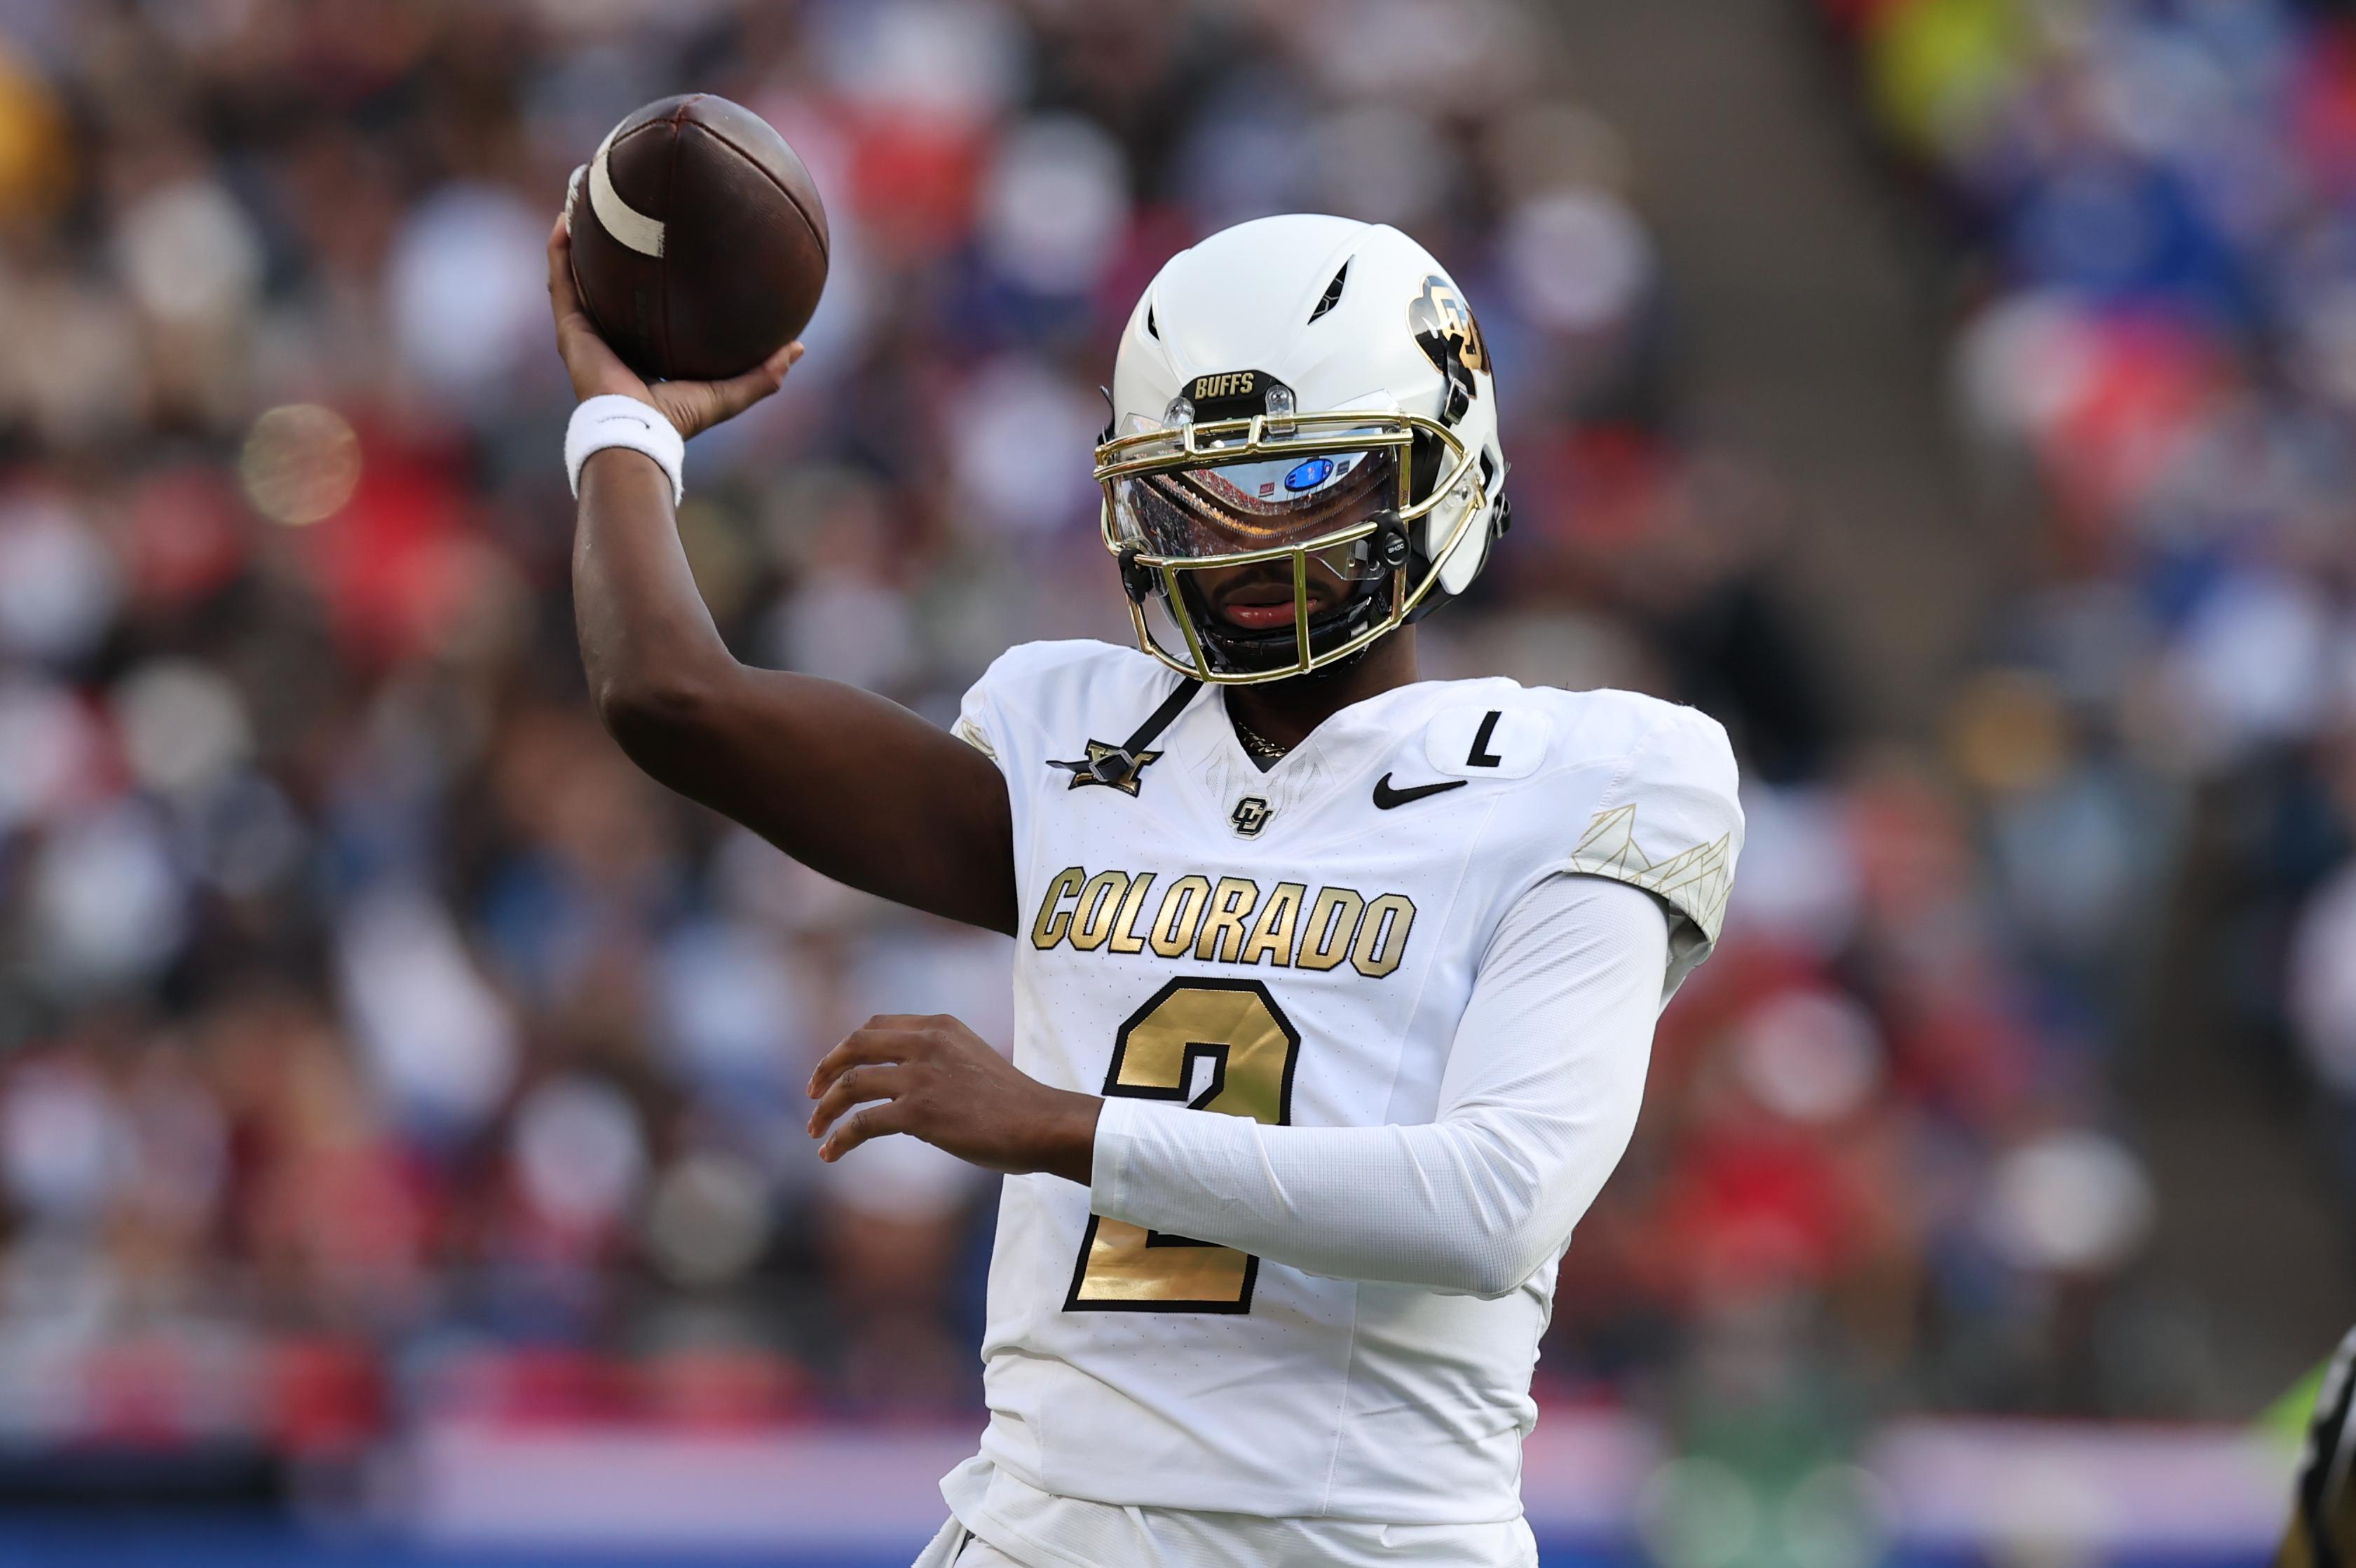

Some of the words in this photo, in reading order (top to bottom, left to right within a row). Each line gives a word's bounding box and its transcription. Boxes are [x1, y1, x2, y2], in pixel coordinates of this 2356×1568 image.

[1194, 372, 1254, 400] BUFFS
[1466, 711, 1502, 767] L
[1031, 866, 1417, 979] COLORADO
[1062, 976, 1302, 1314] 2
